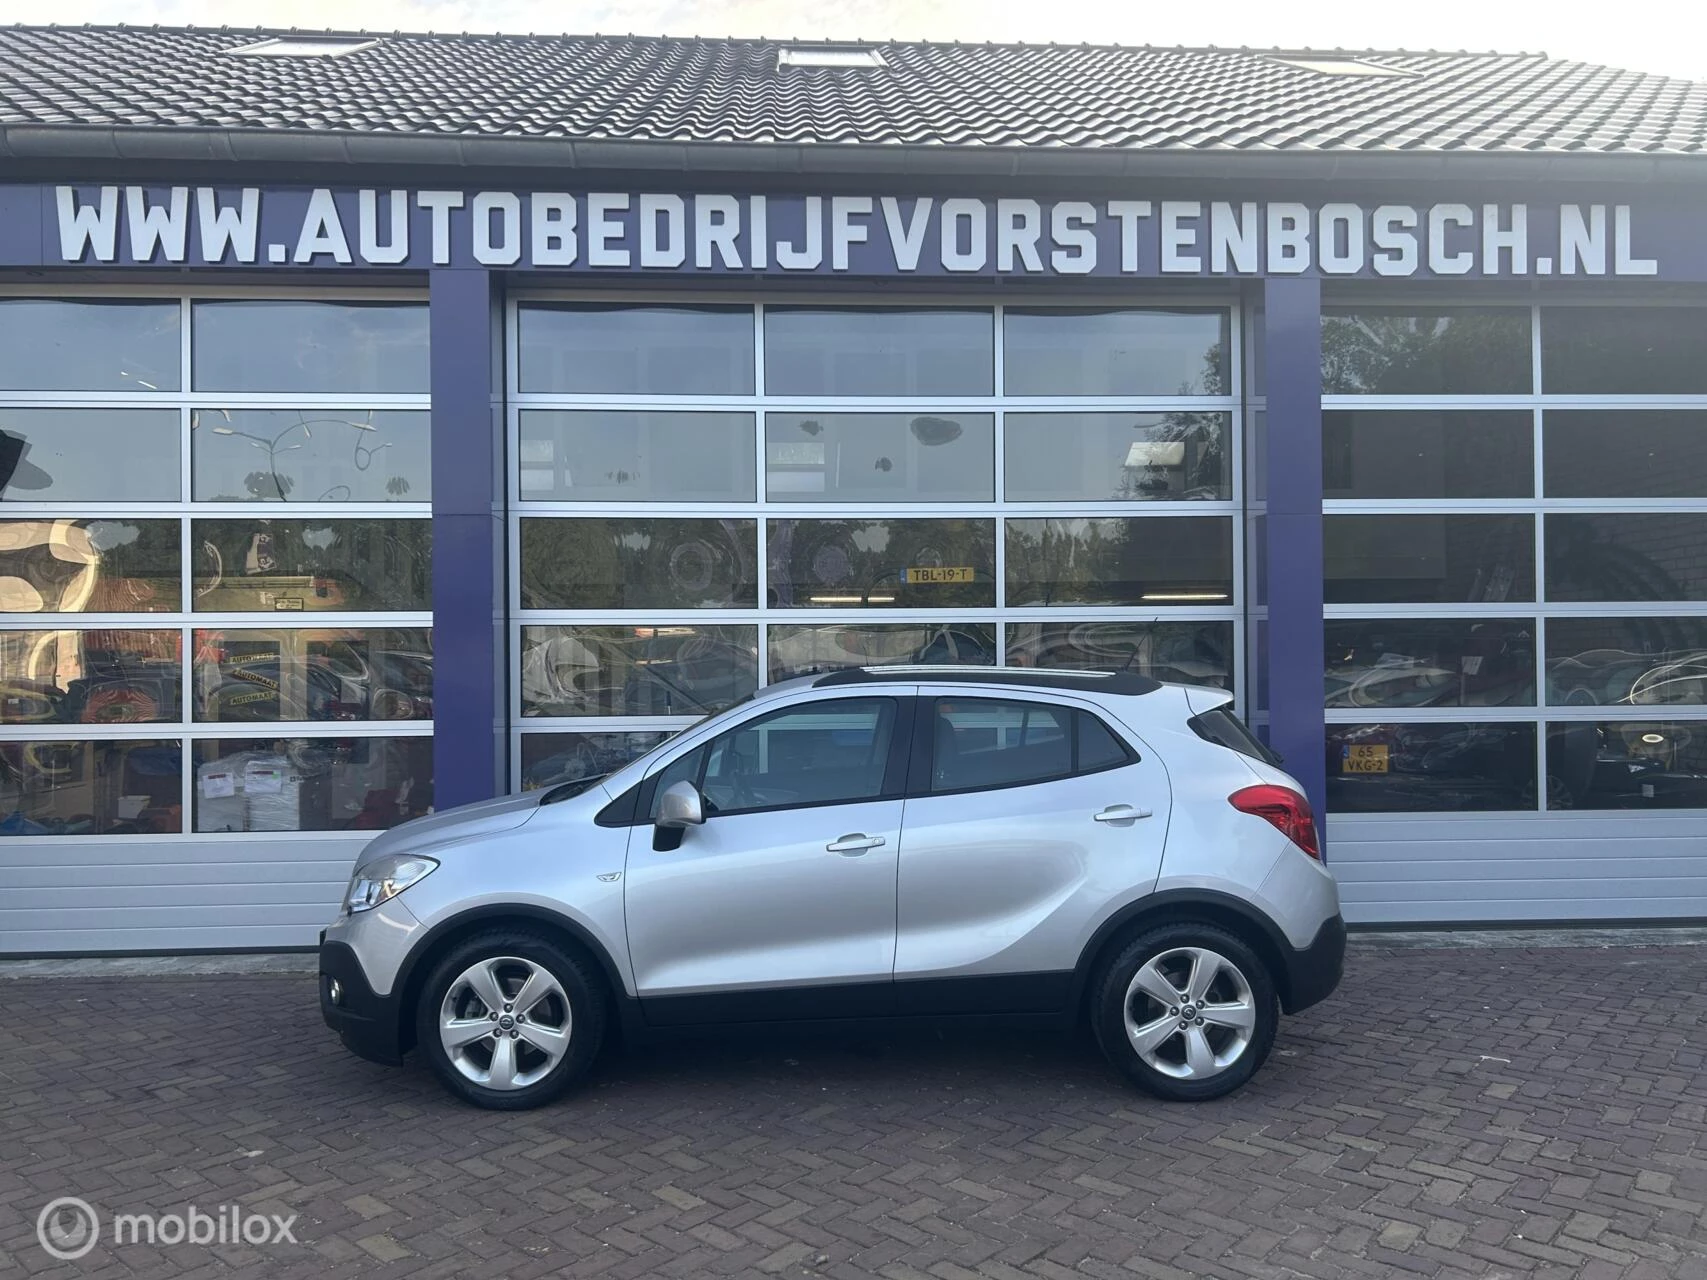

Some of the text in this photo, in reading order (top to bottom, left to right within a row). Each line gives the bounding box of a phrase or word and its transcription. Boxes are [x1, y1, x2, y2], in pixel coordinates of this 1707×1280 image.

[55, 185, 1658, 276] WWW.AUTOBEDRIJFVORSTENBOSCH.NL
[913, 568, 968, 581] TBL-19-T
[237, 669, 277, 688] AUTOMAAT
[1358, 746, 1374, 758] 65
[1348, 760, 1384, 771] VKG-2
